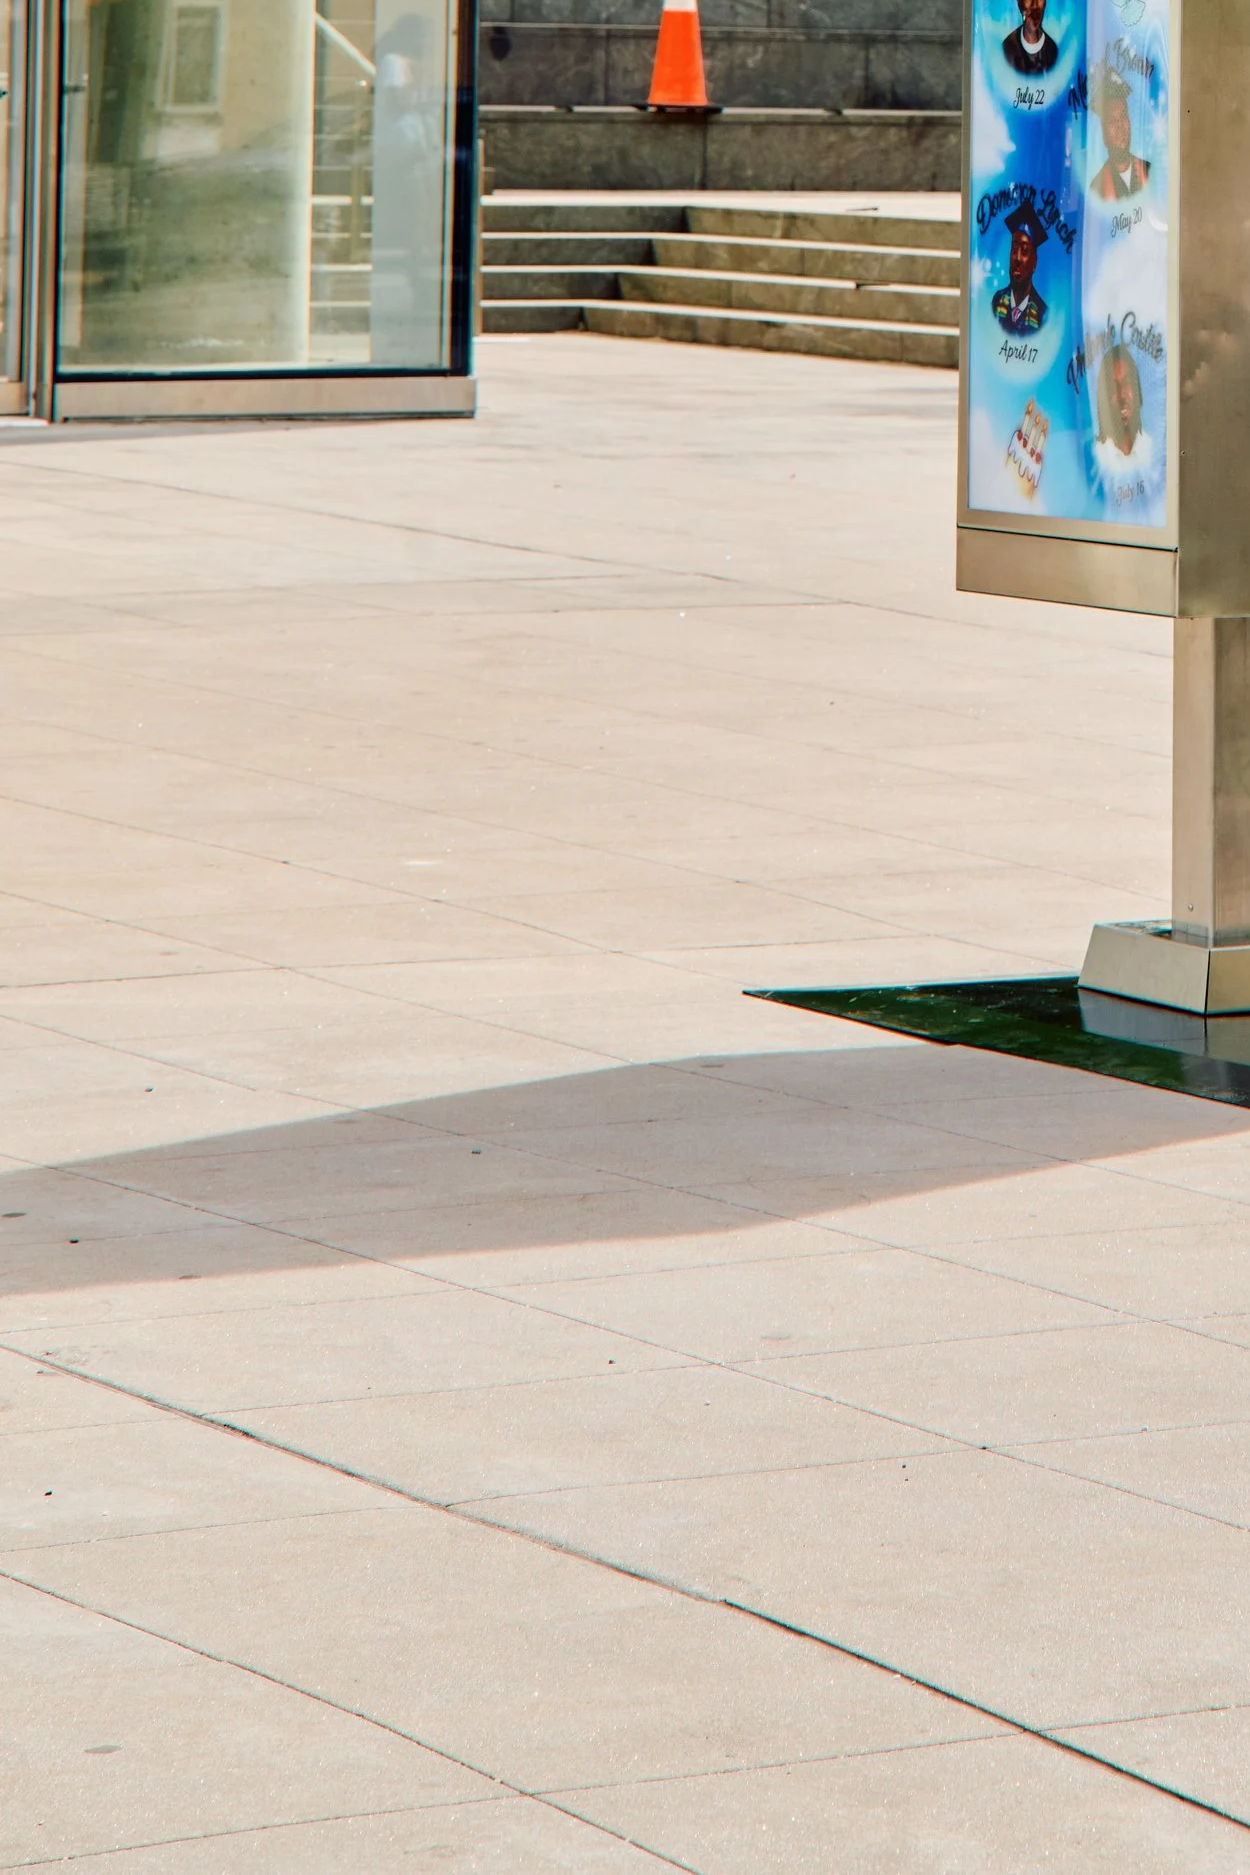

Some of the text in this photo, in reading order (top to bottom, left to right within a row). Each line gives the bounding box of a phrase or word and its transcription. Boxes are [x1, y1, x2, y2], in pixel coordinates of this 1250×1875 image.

[1013, 86, 1045, 110] July 22
[1111, 207, 1143, 238] May 20
[999, 339, 1038, 364] April 17
[1136, 480, 1144, 495] 16
